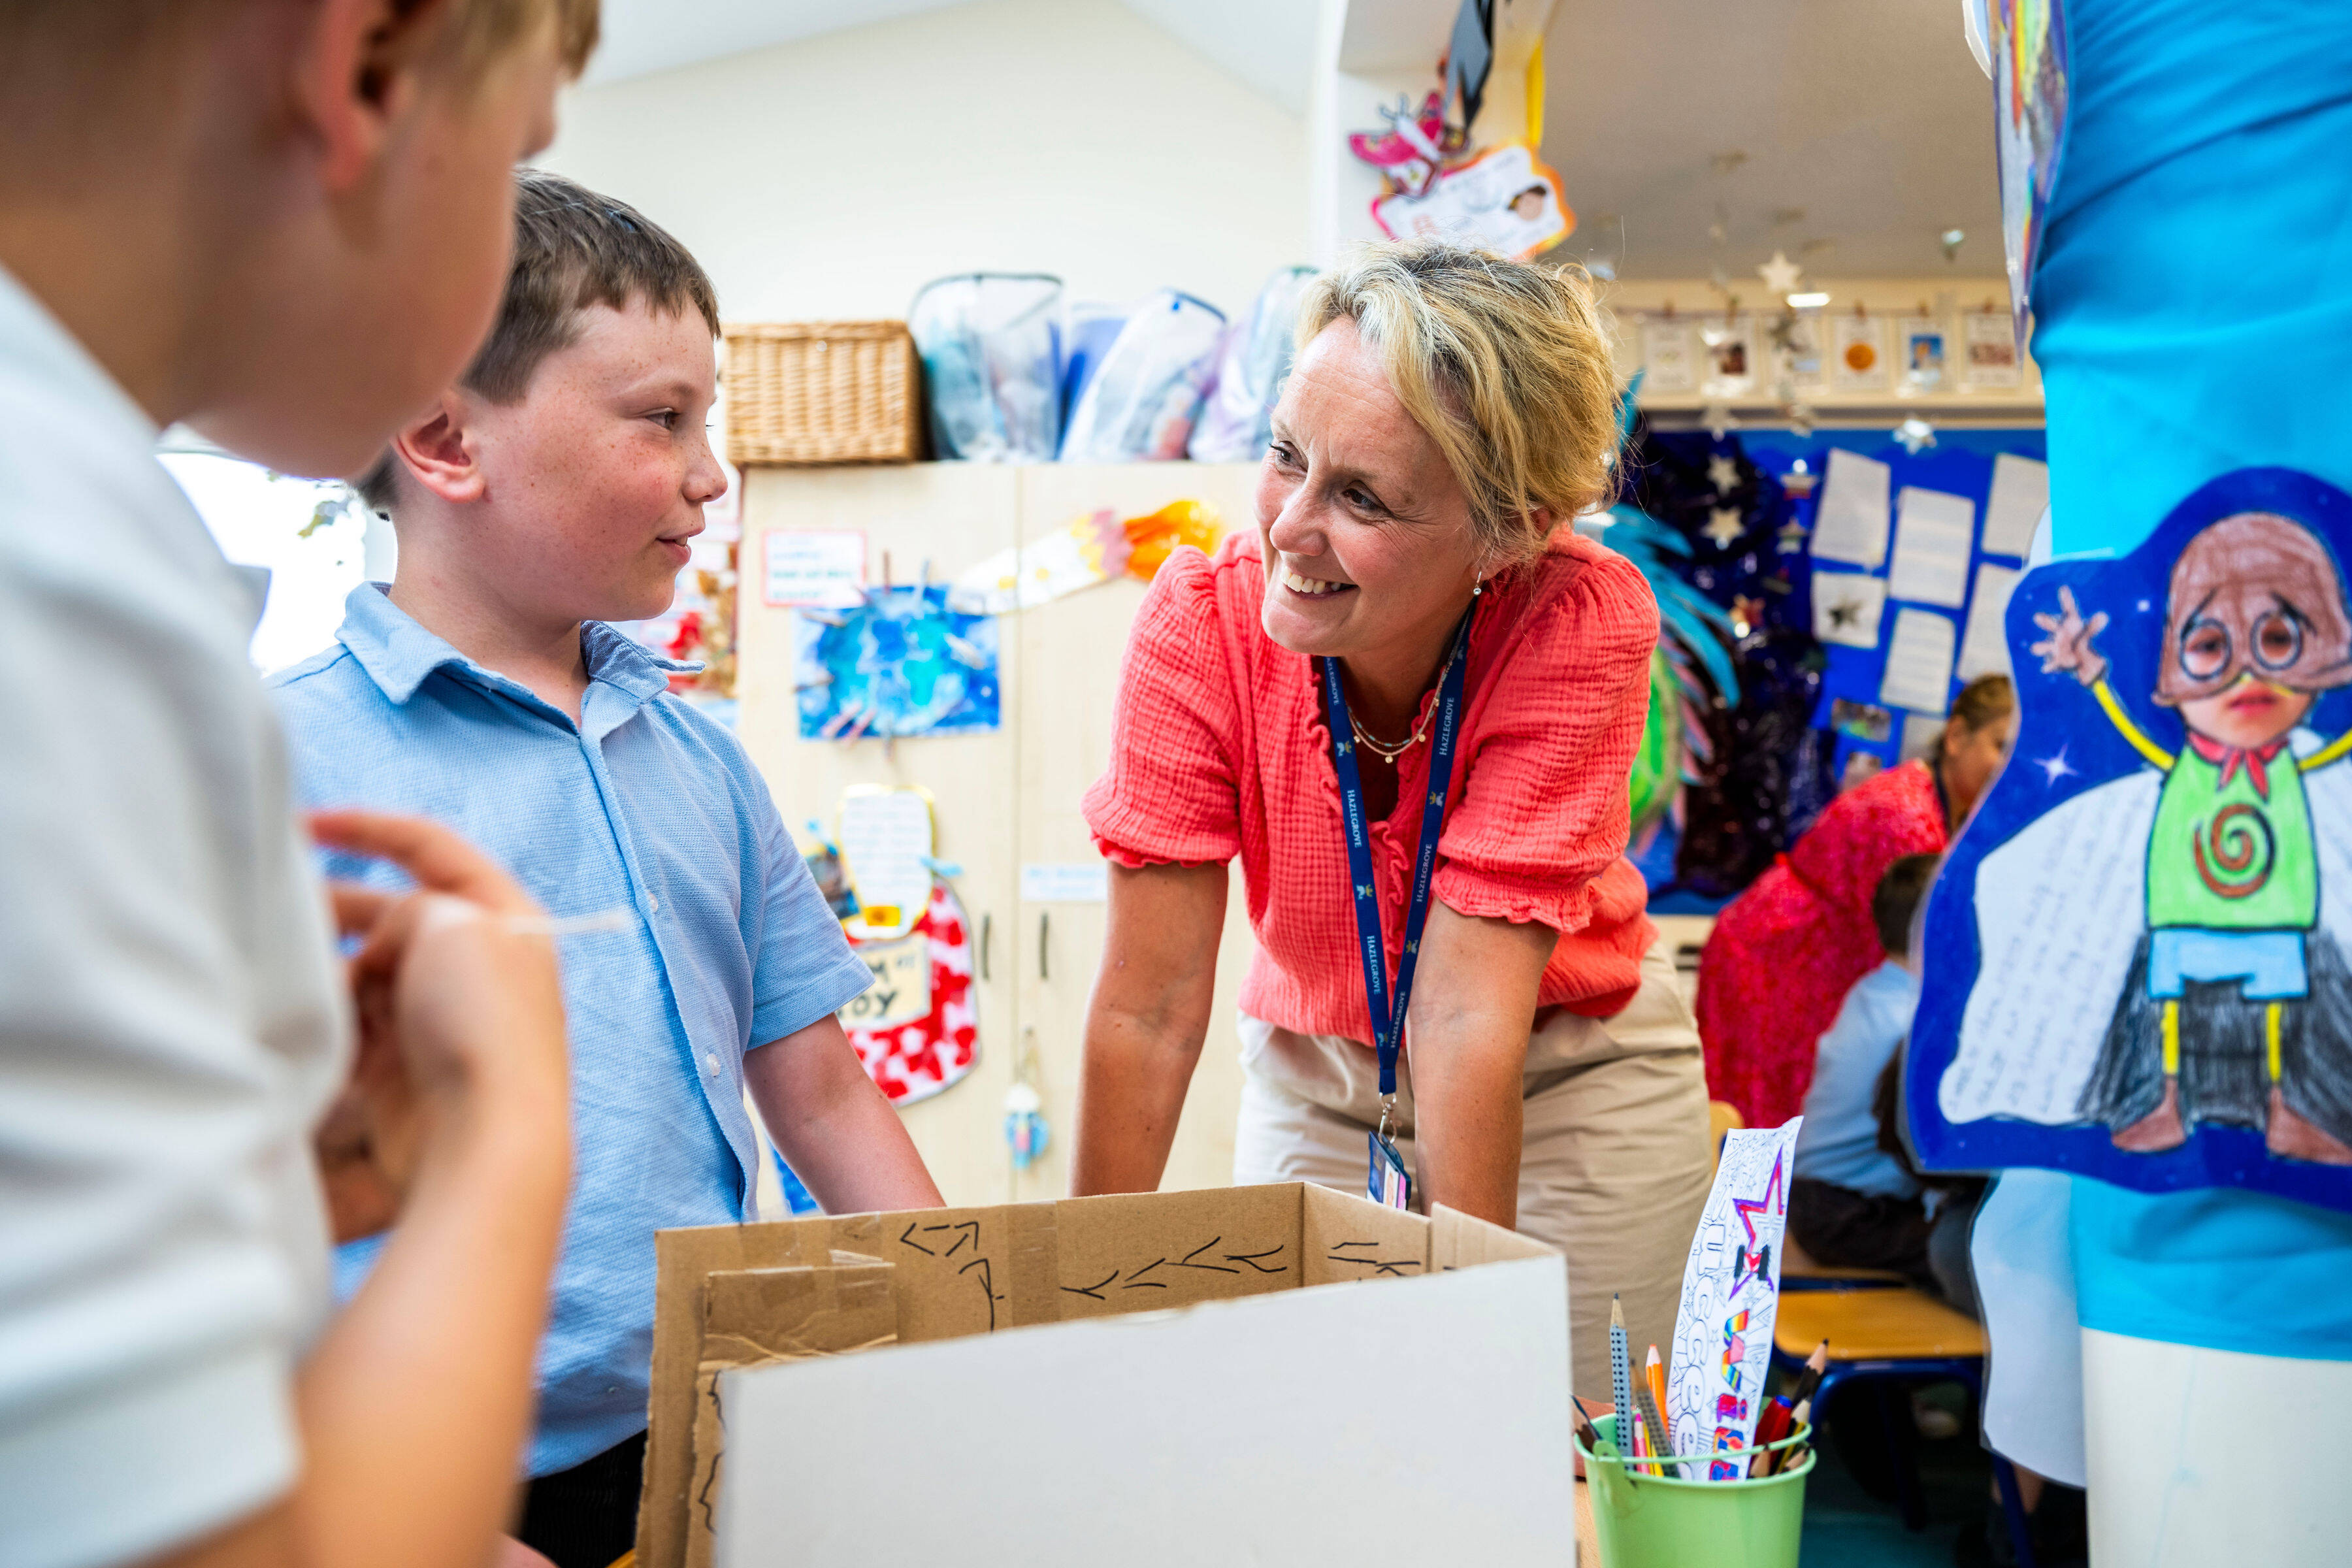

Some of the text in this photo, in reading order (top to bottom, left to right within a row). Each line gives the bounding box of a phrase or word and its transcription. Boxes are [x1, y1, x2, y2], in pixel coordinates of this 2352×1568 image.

[1327, 657, 1339, 706] AZLEGROVE
[1439, 697, 1454, 755] HAZLEGROVE
[1347, 789, 1362, 847] HAZLEGROVE
[1416, 844, 1432, 902] HAZLEGROVE
[1367, 936, 1380, 994] HAZLEGROVE
[836, 990, 898, 1019] OY
[1390, 991, 1406, 1049] HAZLEGROVE
